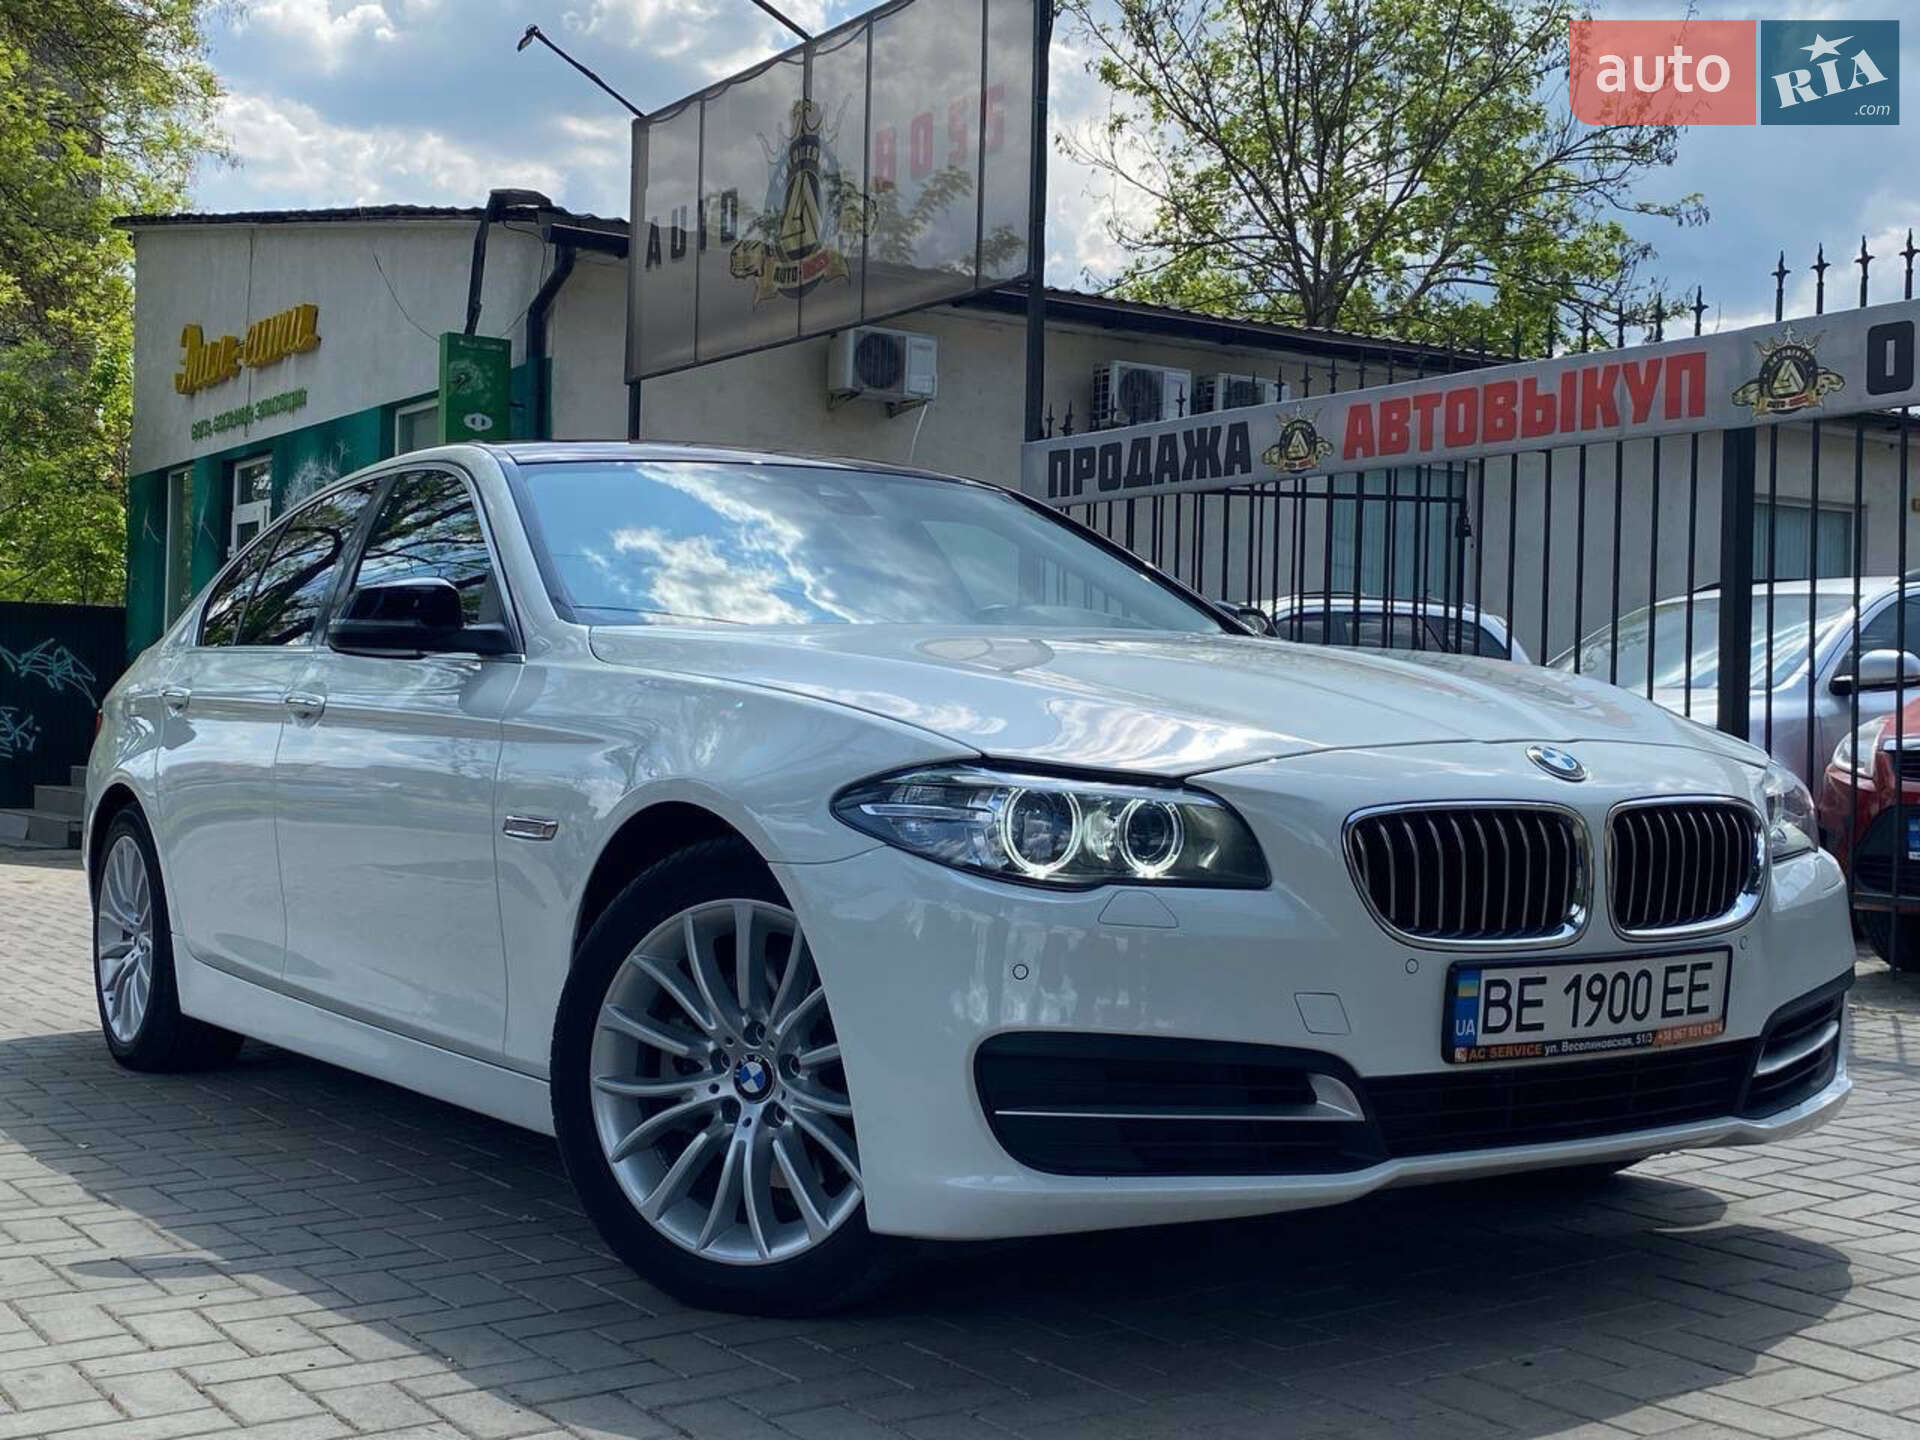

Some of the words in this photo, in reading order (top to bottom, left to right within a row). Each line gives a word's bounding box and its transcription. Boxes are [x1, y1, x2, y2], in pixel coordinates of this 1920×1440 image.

[645, 187, 738, 271] AUTO
[1048, 421, 1251, 498] ПРОДАЖА
[1343, 352, 1706, 461] АВТОВЫКУП
[1455, 1019, 1475, 1036] UA
[1482, 976, 1547, 1034] BE
[1563, 969, 1652, 1028] 1900
[1661, 962, 1713, 1018] EE
[1488, 1043, 1542, 1058] SERVICE
